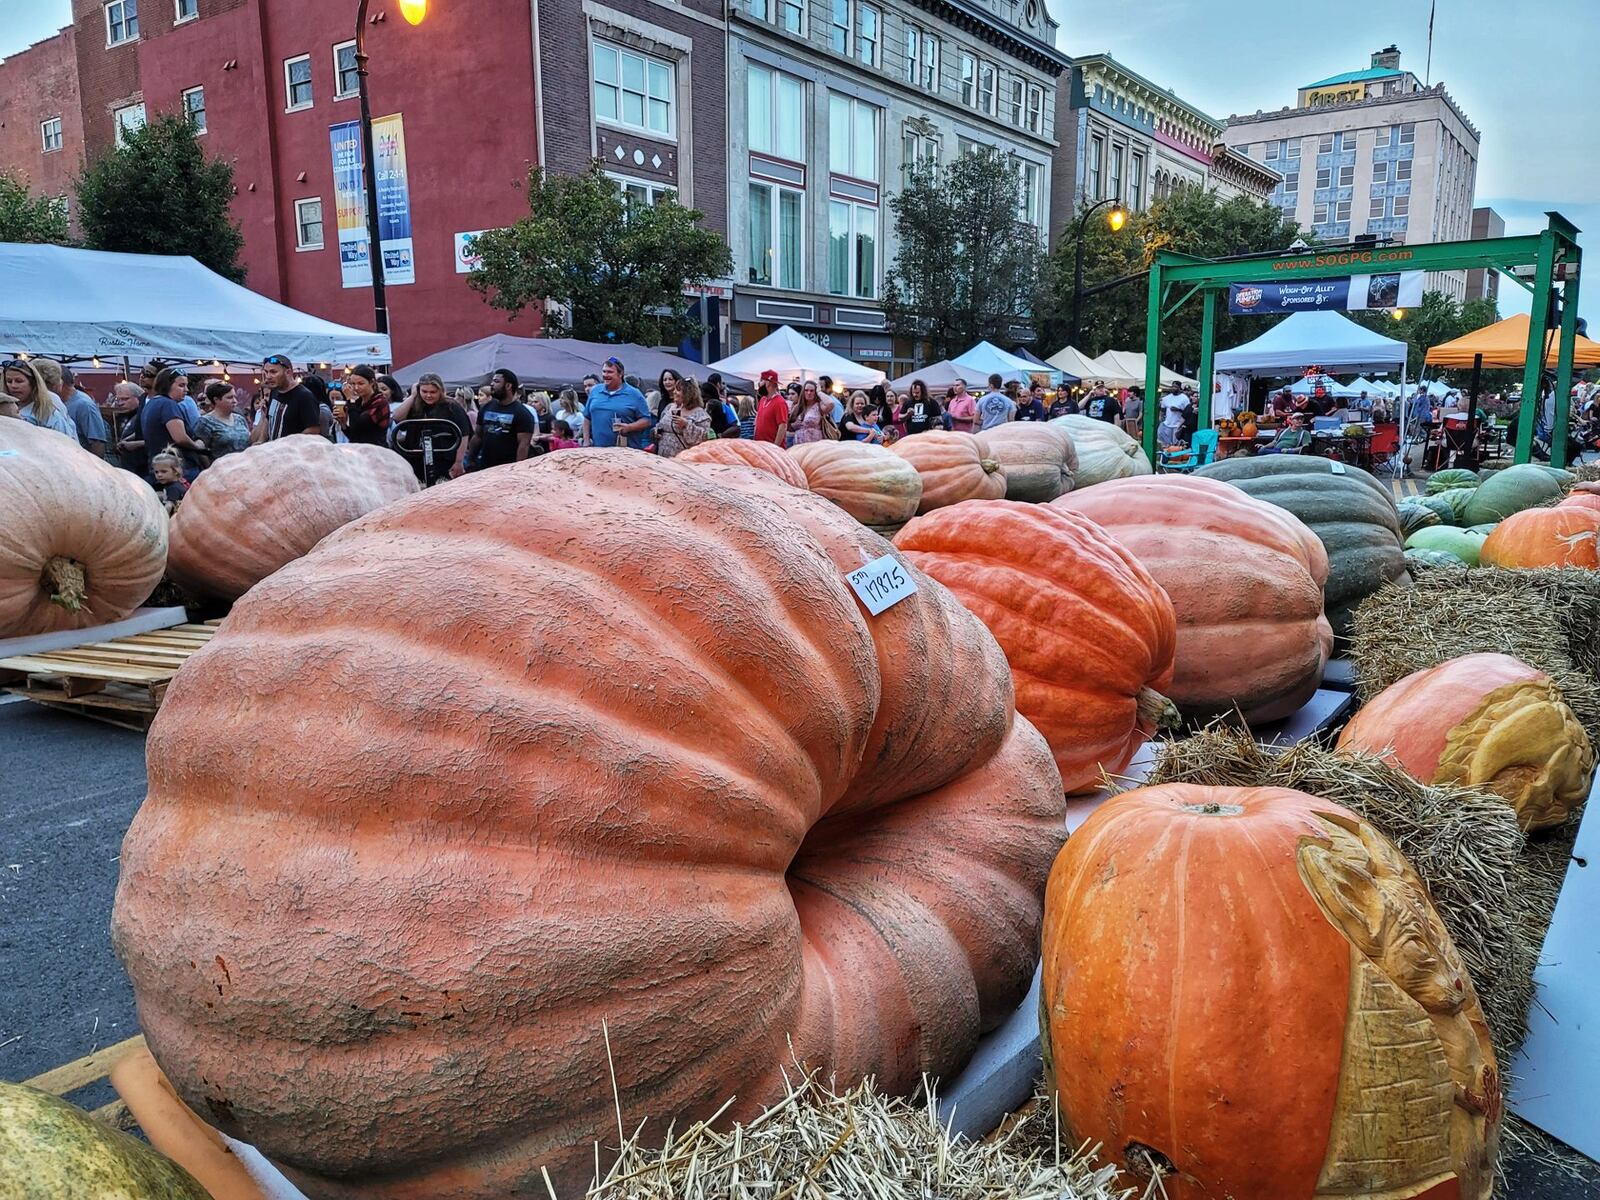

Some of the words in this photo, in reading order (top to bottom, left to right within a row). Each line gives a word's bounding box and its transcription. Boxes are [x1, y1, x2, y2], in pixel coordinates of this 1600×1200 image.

[377, 170, 388, 181] Call
[389, 169, 404, 179] 2-1-1
[341, 242, 357, 252] United
[347, 251, 358, 261] Way
[385, 251, 400, 260] United
[390, 259, 400, 268] Way
[1272, 251, 1413, 271] www.SOGPG.com
[864, 566, 905, 603] 1787.5
